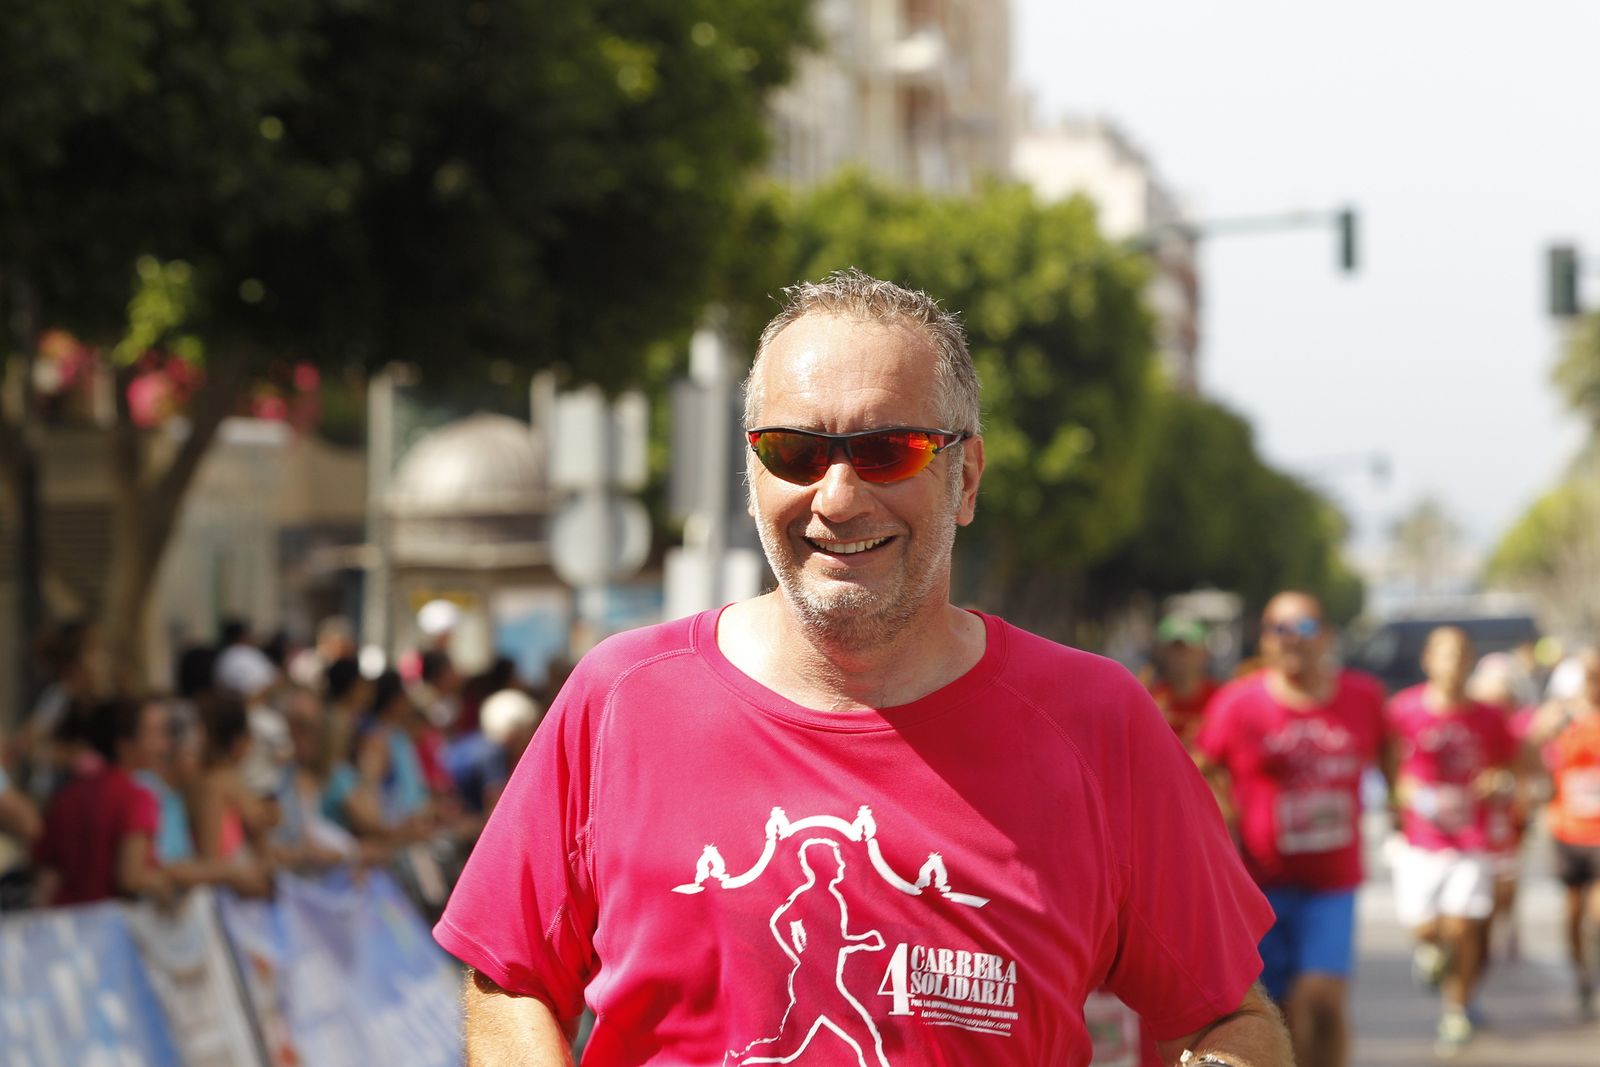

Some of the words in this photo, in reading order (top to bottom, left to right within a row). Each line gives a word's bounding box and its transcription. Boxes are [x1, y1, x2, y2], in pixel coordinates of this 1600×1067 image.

[877, 943, 917, 1016] 4
[910, 945, 1017, 984] CARRERA
[910, 971, 1015, 1007] SOLIDARIA
